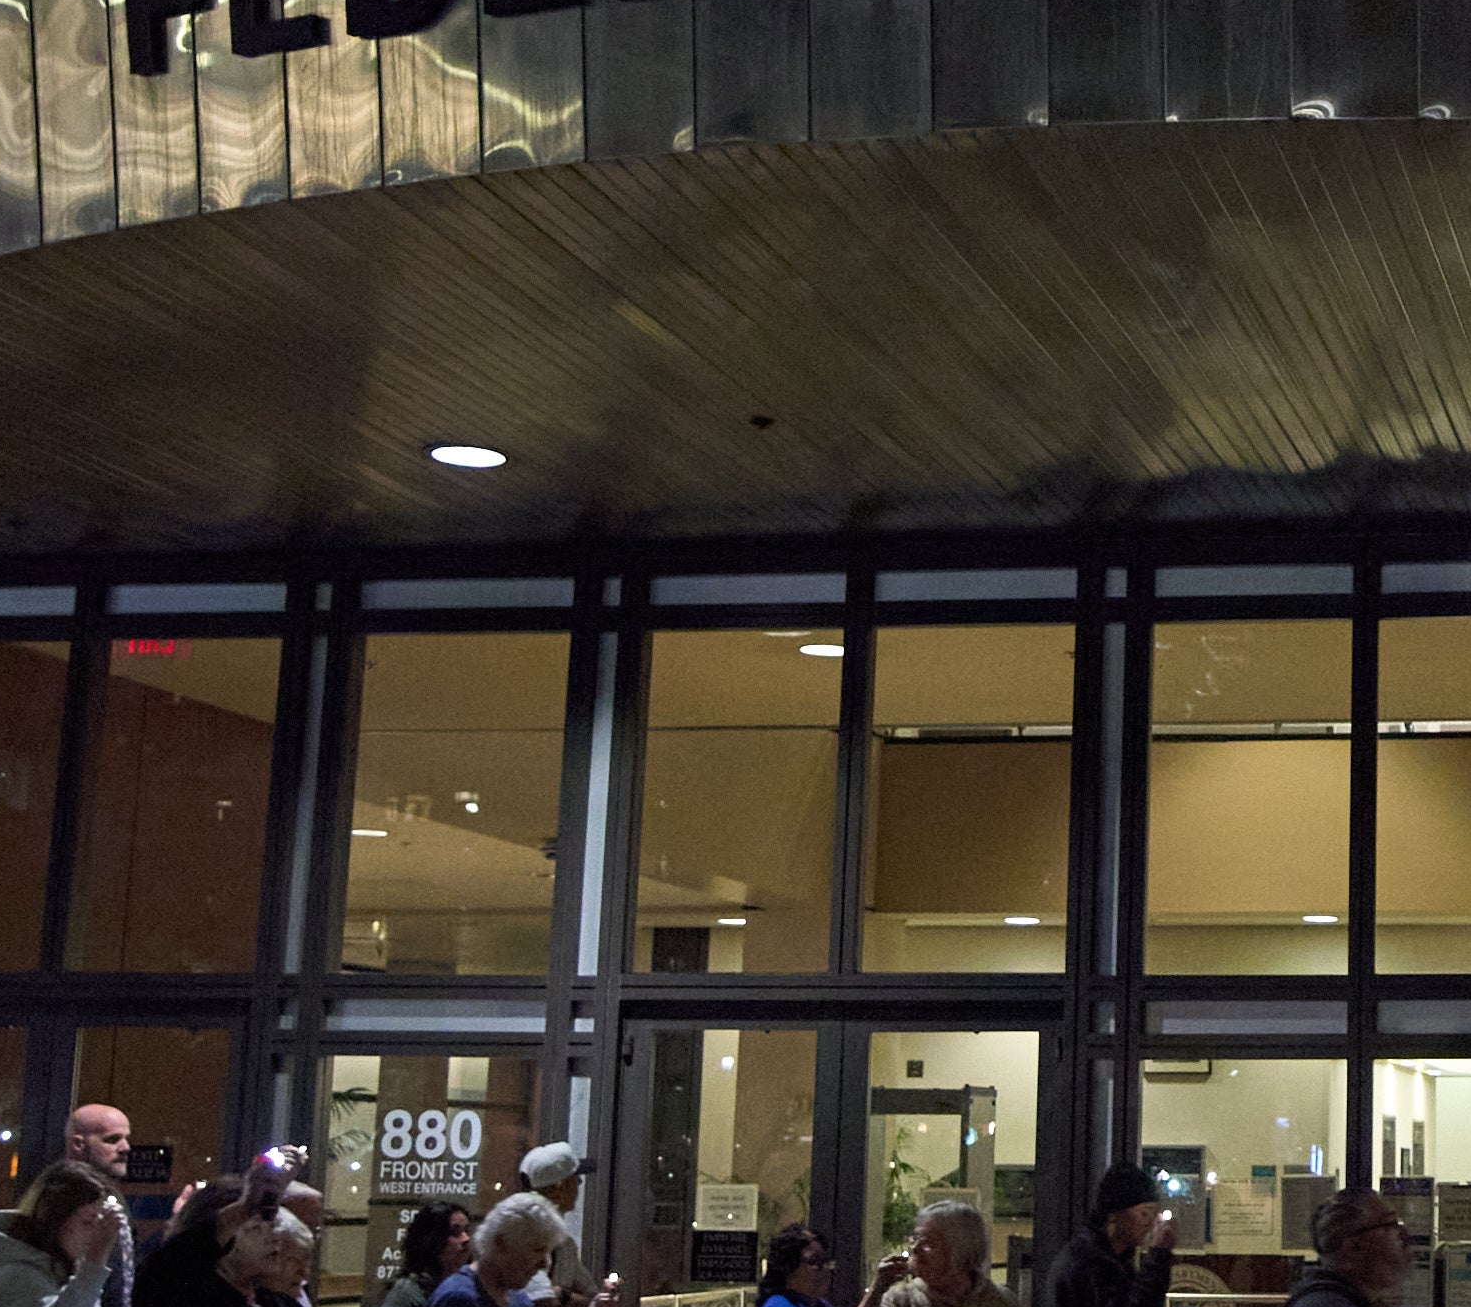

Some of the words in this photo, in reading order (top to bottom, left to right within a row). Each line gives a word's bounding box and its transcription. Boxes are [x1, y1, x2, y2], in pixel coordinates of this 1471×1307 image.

[381, 1109, 482, 1159] 880
[380, 1161, 448, 1180] FRONT
[452, 1161, 479, 1180] ST
[380, 1182, 411, 1193] WEST
[414, 1182, 477, 1194] ENTRANCE
